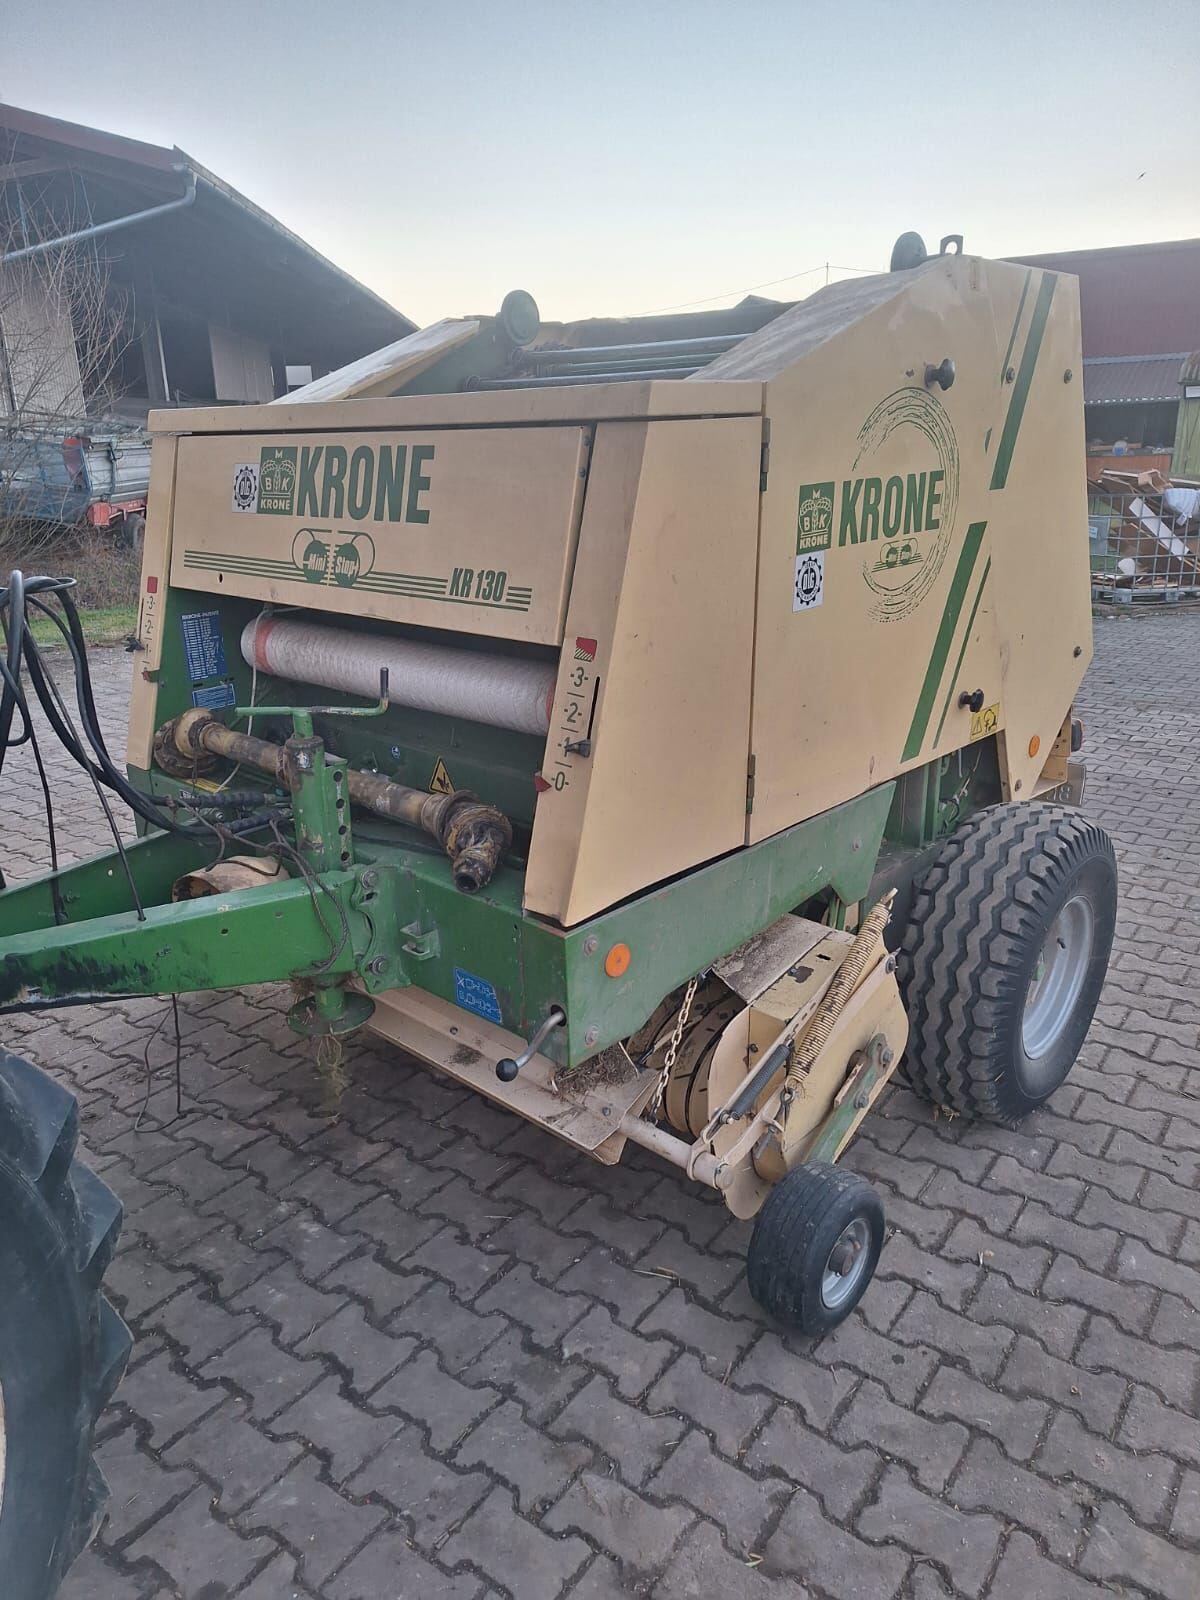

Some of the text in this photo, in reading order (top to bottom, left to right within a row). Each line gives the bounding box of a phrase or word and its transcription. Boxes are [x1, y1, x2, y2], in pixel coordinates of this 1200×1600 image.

[297, 445, 435, 524] KRONE
[260, 498, 291, 510] KRONE
[839, 470, 945, 547] KRONE
[799, 534, 829, 550] KRONE
[307, 553, 327, 572] Mini
[449, 567, 507, 602] KR 130
[573, 666, 585, 687] 3
[566, 702, 578, 723] 2
